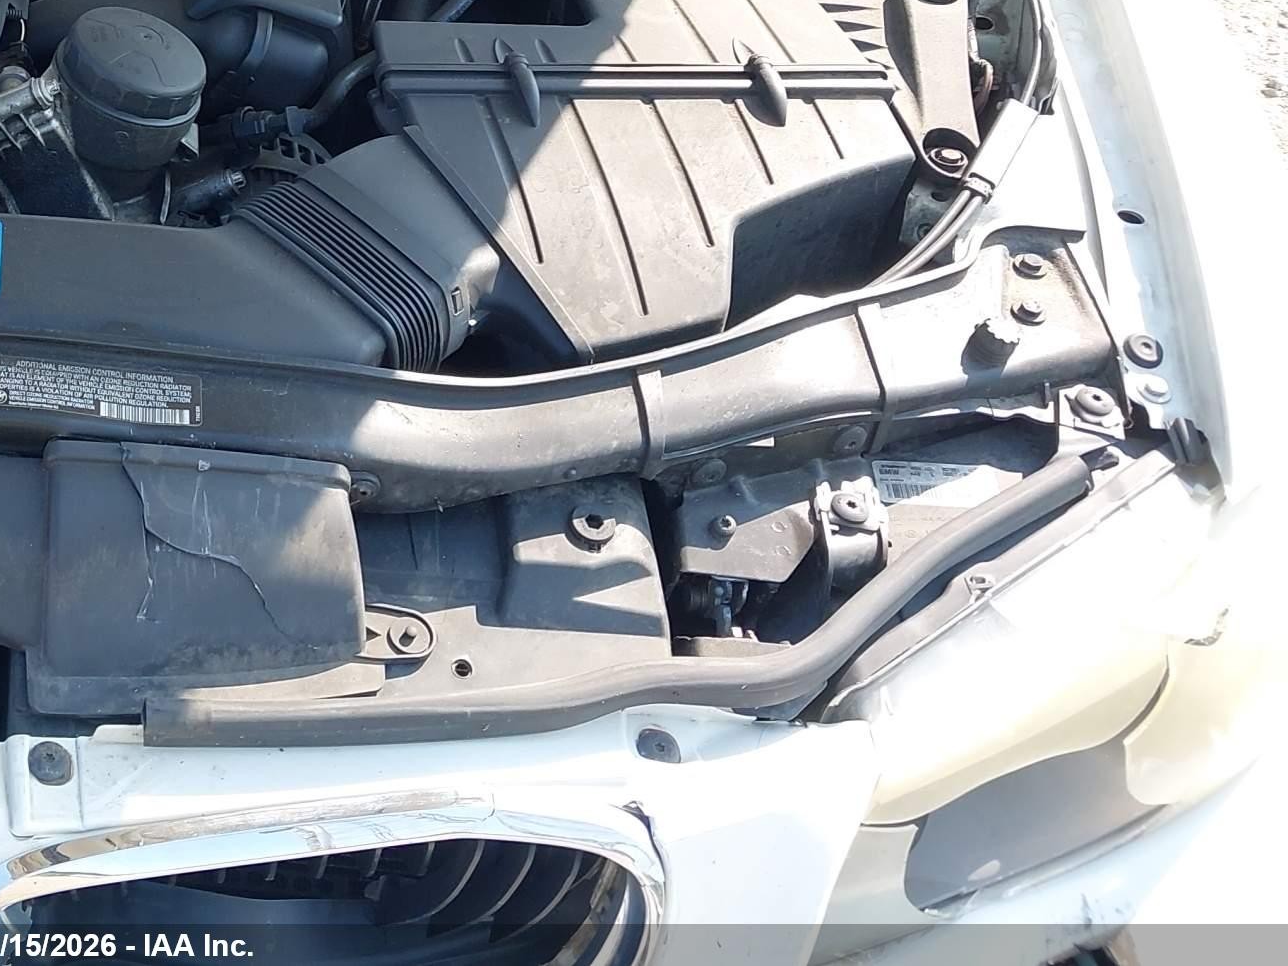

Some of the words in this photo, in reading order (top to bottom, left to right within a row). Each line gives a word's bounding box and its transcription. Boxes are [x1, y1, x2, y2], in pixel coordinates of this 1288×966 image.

[16, 360, 57, 371] ADDITIONAL
[57, 364, 91, 374] EMISSION
[92, 368, 124, 378] CONTROL
[125, 372, 174, 383] INFORMATION
[26, 374, 55, 383] ELEMENT
[78, 380, 104, 389] VEHICLE
[104, 383, 134, 392] EMISSION
[134, 387, 164, 395] CONTROL
[39, 381, 69, 390] RADIATOR
[69, 385, 96, 393] WITHOUT
[97, 388, 133, 399] EQUIVALENT
[134, 393, 156, 401] OZONE
[156, 395, 192, 403] REDUCTION
[123, 379, 159, 389] REDUCTION
[159, 383, 192, 392] RADIATOR
[41, 386, 73, 396] VIOLATION
[94, 394, 128, 404] POLLUTION
[128, 398, 169, 408] REGULATION.
